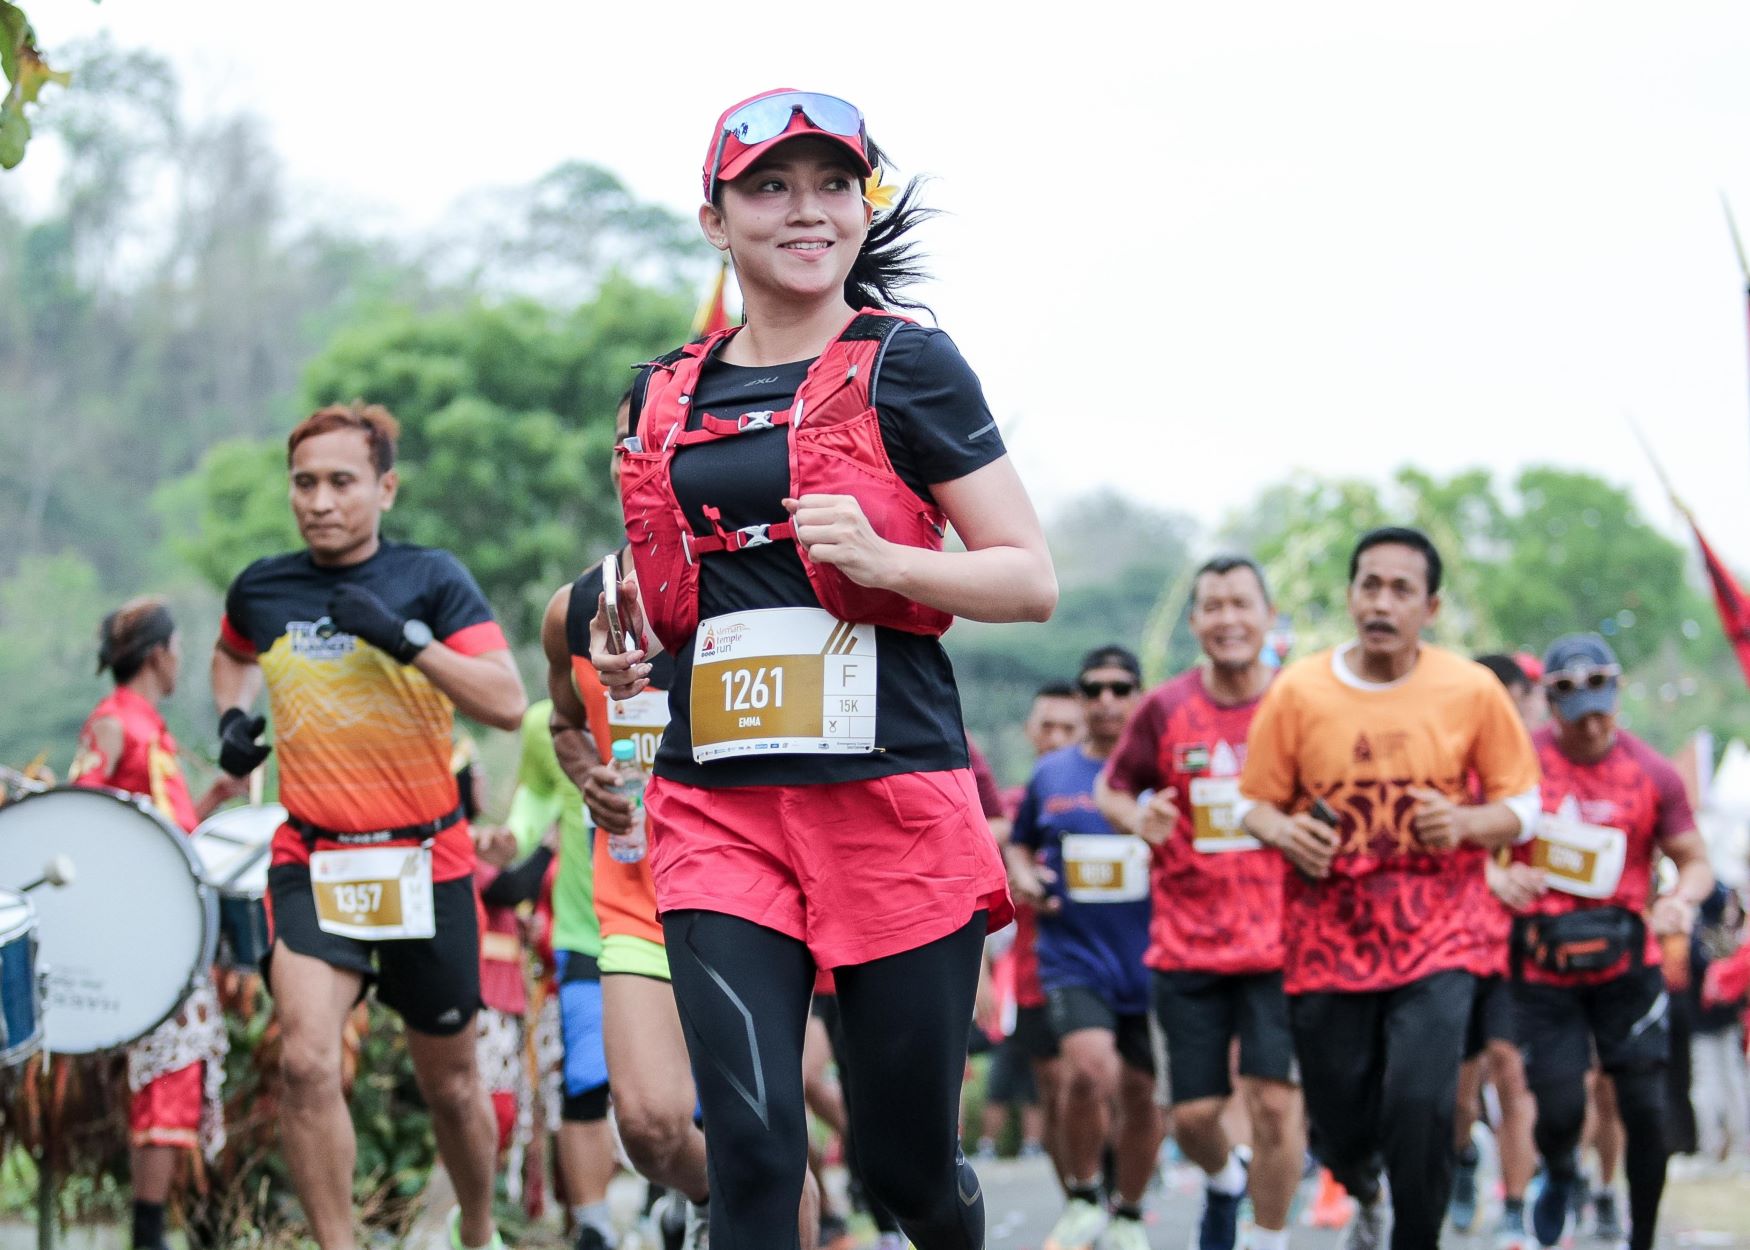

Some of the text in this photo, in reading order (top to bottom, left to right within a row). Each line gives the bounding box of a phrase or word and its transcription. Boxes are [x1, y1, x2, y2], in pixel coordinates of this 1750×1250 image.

[716, 644, 732, 654] run
[843, 664, 858, 687] F
[721, 666, 784, 711] 1261
[839, 699, 858, 713] 15K
[738, 716, 761, 728] EMMA
[334, 883, 383, 913] 1357
